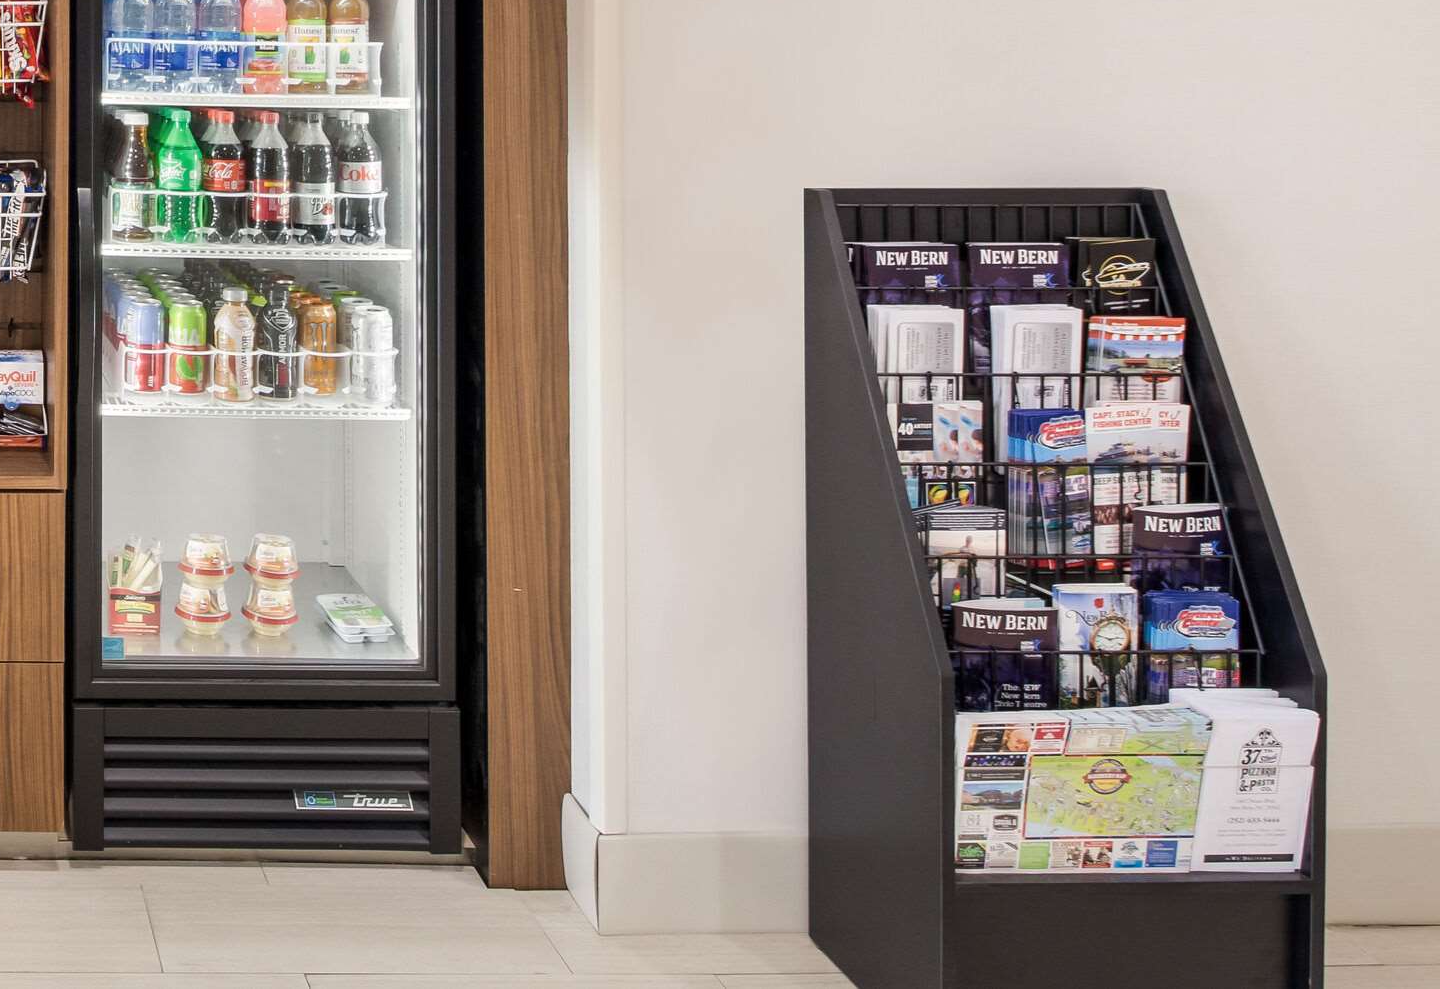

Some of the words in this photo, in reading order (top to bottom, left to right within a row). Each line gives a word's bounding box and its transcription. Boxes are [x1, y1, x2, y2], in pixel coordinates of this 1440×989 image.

[111, 42, 145, 55] ASANI
[340, 163, 378, 182] Coke
[876, 250, 909, 267] NEW
[910, 250, 949, 266] BERN
[979, 249, 1016, 265] NEW
[1017, 249, 1059, 265] BERN
[1116, 410, 1140, 418] STACY
[897, 422, 914, 436] 40
[1093, 420, 1123, 428] FISHING
[1124, 418, 1152, 427] CENTER
[1144, 515, 1183, 532] NEW
[1185, 515, 1221, 533] BERN
[962, 611, 1002, 630] NEW
[1005, 614, 1048, 631] BERN
[1001, 683, 1019, 691] The
[1241, 749, 1262, 765] 37
